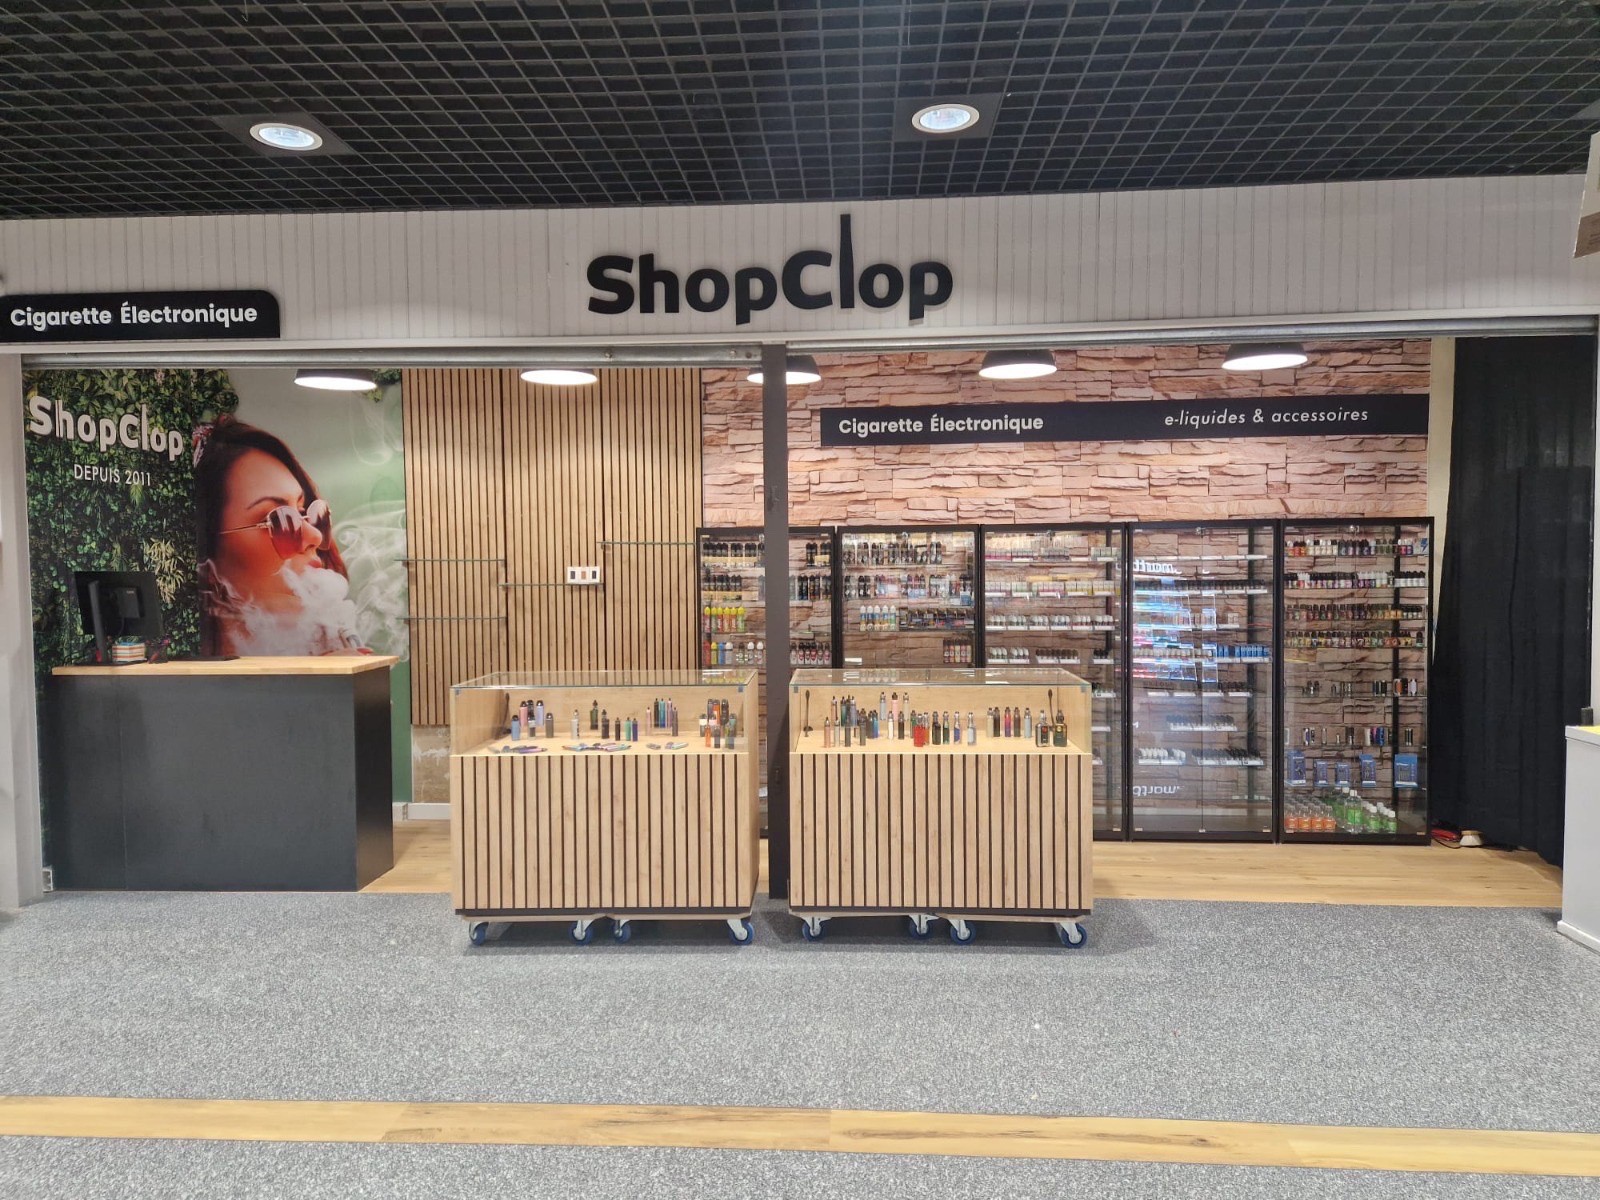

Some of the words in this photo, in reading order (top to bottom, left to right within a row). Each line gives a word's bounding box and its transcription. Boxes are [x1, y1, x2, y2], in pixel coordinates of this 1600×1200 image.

[586, 213, 953, 326] ShopClop
[10, 307, 112, 332] Cigarette
[120, 301, 258, 328] Électronique
[29, 395, 184, 461] ShopClop
[838, 418, 923, 437] Cigarette
[930, 413, 1044, 434] Électronique
[1165, 408, 1246, 429] e-liquides
[1252, 408, 1264, 423] &
[1271, 406, 1368, 423] accessoires
[74, 464, 121, 484] DEPUIS
[125, 470, 150, 486] 2011
